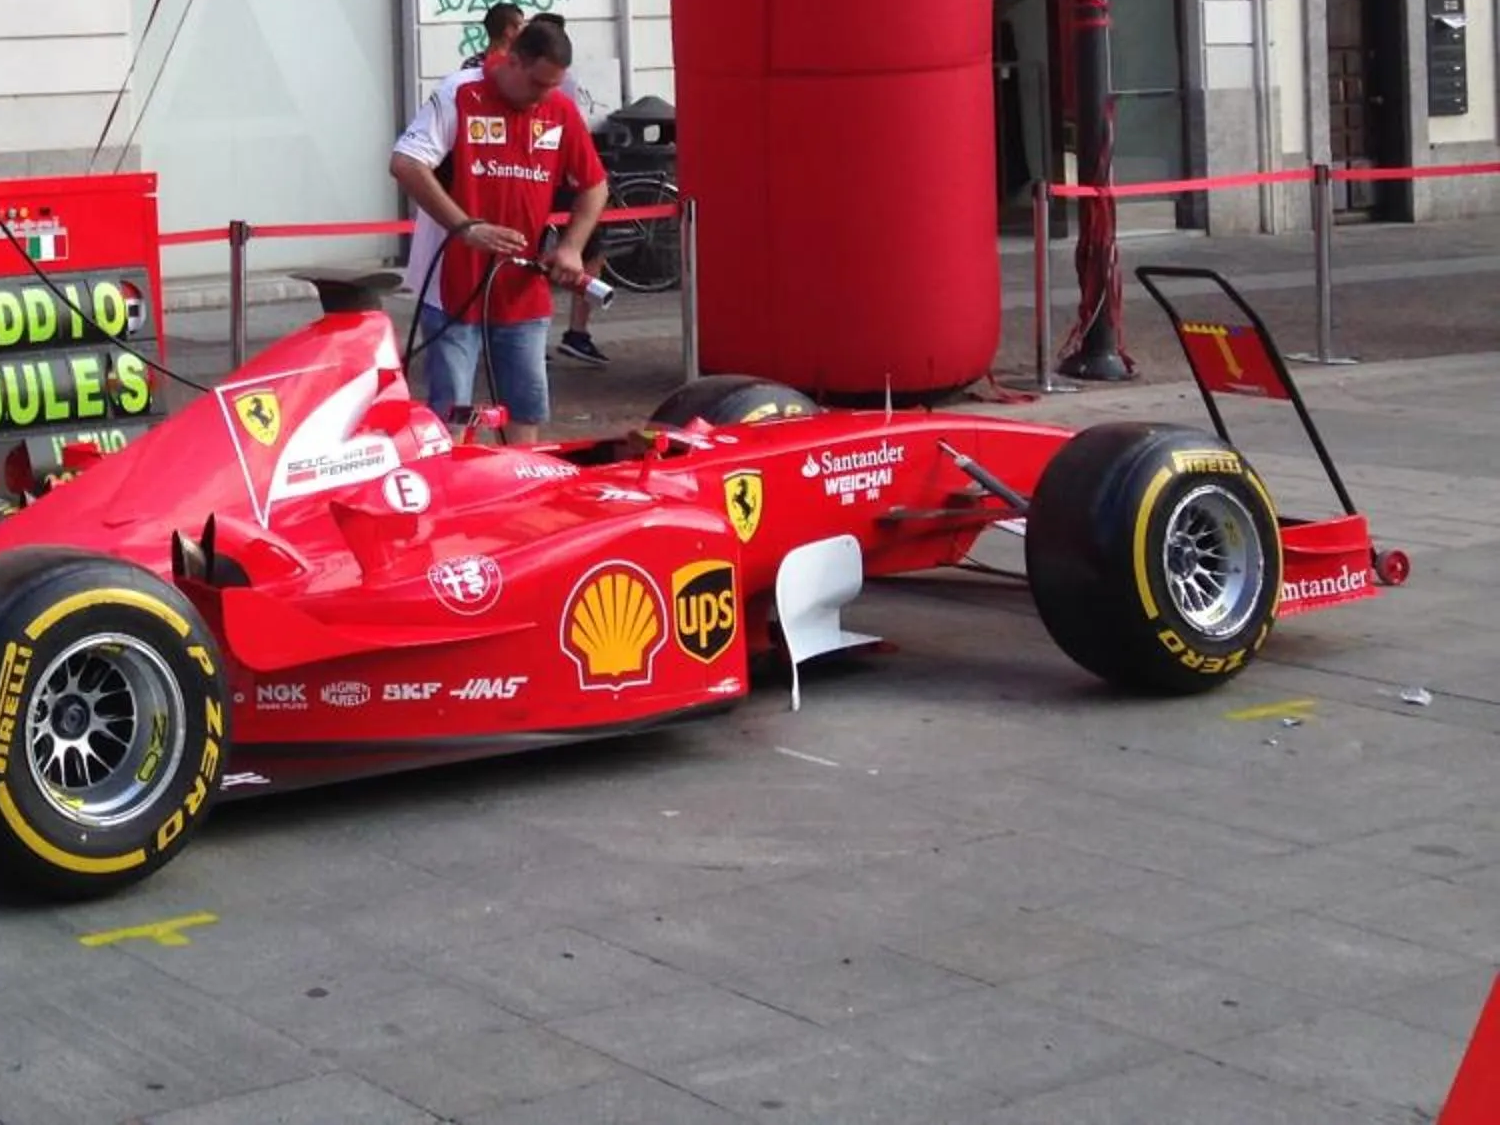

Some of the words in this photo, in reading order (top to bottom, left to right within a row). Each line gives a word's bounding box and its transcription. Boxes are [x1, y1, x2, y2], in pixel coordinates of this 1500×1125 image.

[486, 159, 551, 182] Santander
[821, 438, 905, 475] Santander
[1171, 449, 1243, 474] PIRELLI
[394, 474, 420, 508] E
[824, 466, 892, 496] WEICHAI
[1281, 564, 1368, 602] ntander
[677, 589, 734, 649] ups
[256, 683, 307, 702] NGK
[382, 682, 442, 700] SKF
[156, 696, 223, 851] ZERO
